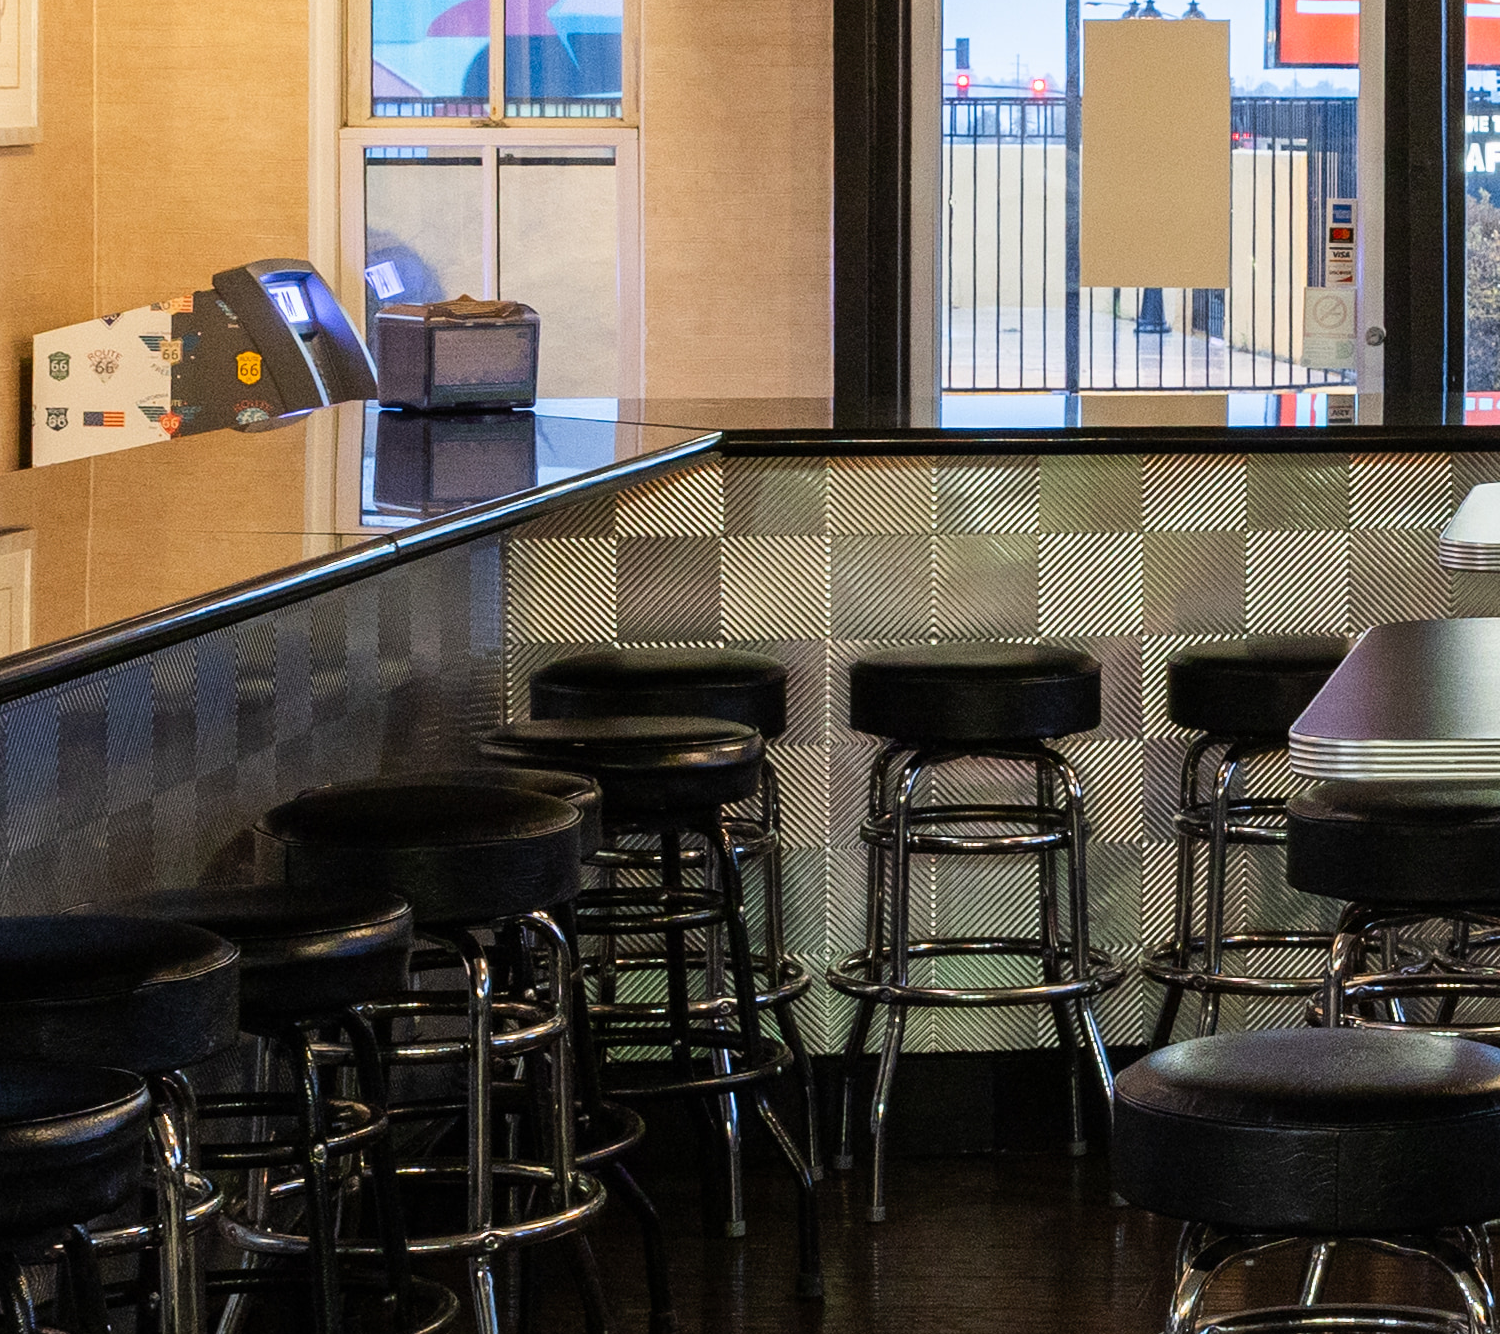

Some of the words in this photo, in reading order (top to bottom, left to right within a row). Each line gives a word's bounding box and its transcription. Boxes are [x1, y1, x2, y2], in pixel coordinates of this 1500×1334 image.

[87, 349, 122, 361] ROUTE
[161, 348, 179, 360] 66
[50, 360, 67, 372] 66
[94, 360, 115, 374] 66
[240, 363, 259, 377] 66
[47, 414, 66, 427] 66
[162, 417, 180, 429] 66
